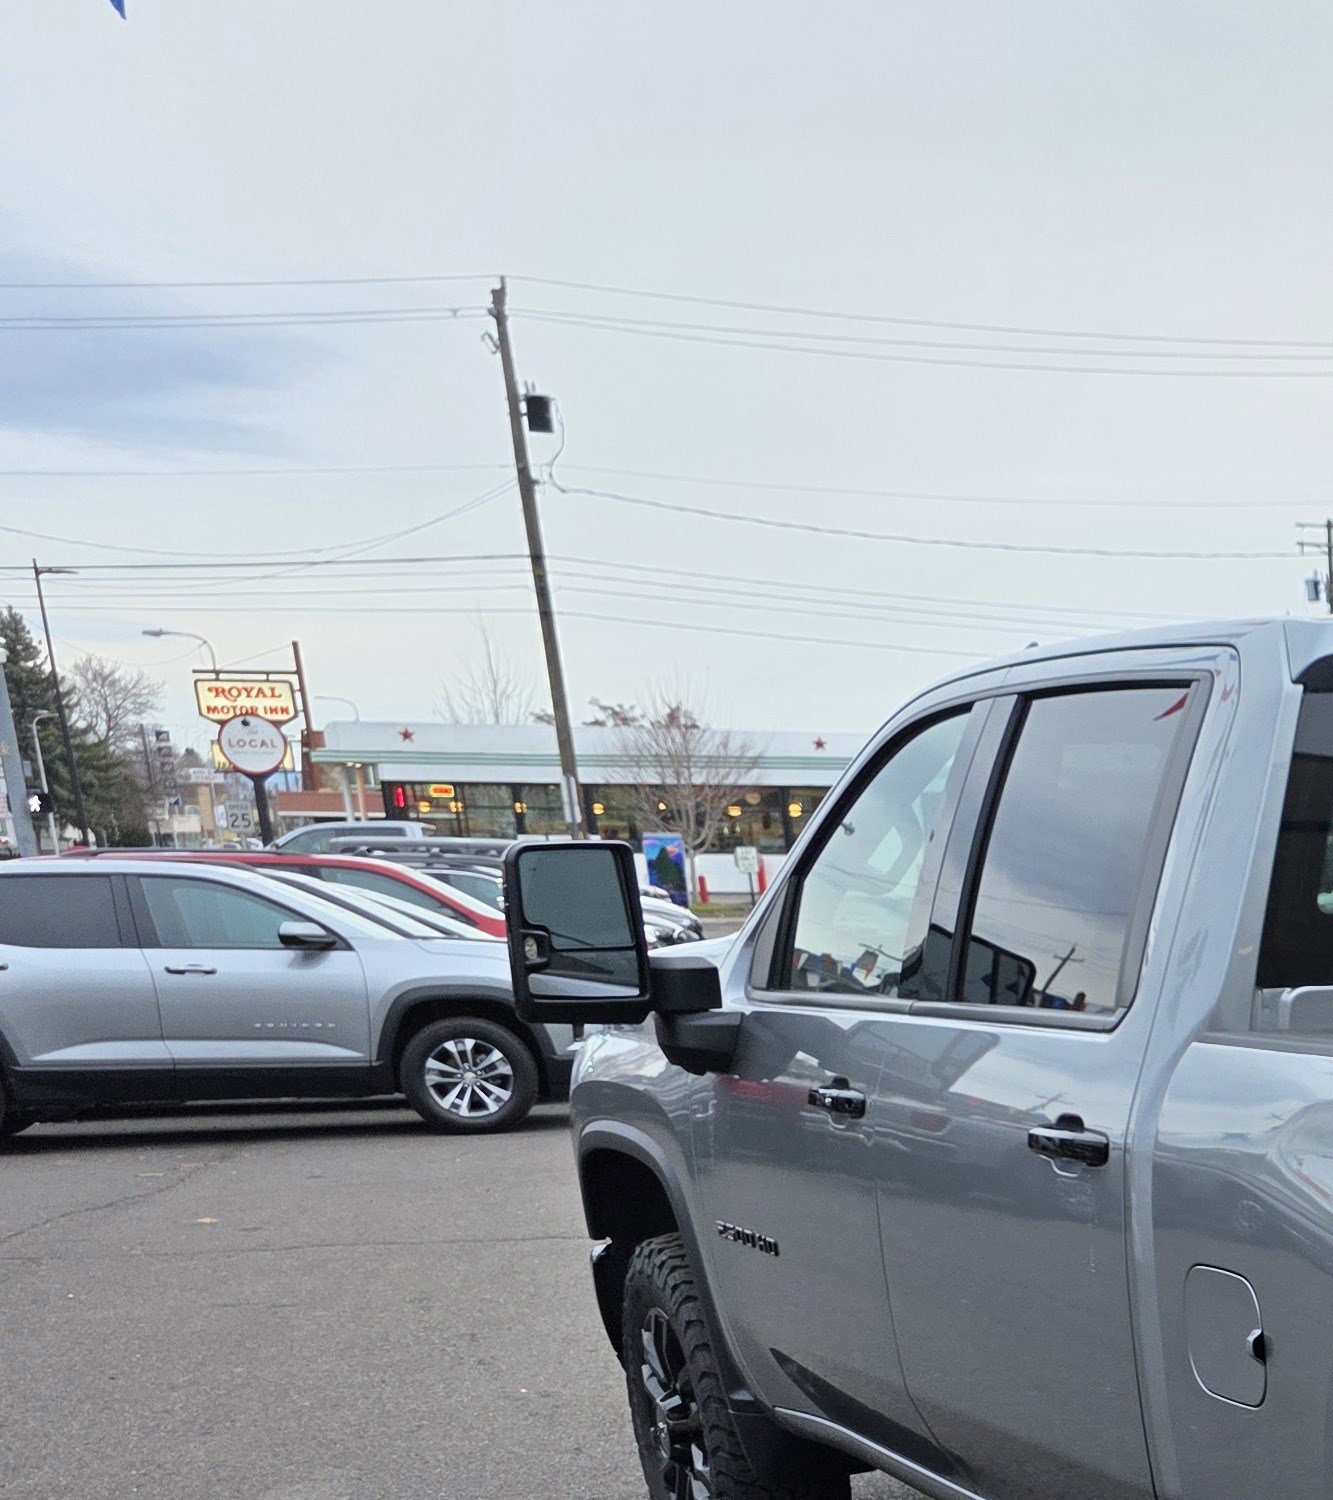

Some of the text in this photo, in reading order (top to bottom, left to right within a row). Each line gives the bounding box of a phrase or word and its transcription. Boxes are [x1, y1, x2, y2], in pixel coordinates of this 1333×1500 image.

[207, 686, 282, 702] ROYAL
[206, 705, 290, 715] MOTOR INN
[228, 738, 278, 748] LOCAL
[229, 813, 251, 828] 25
